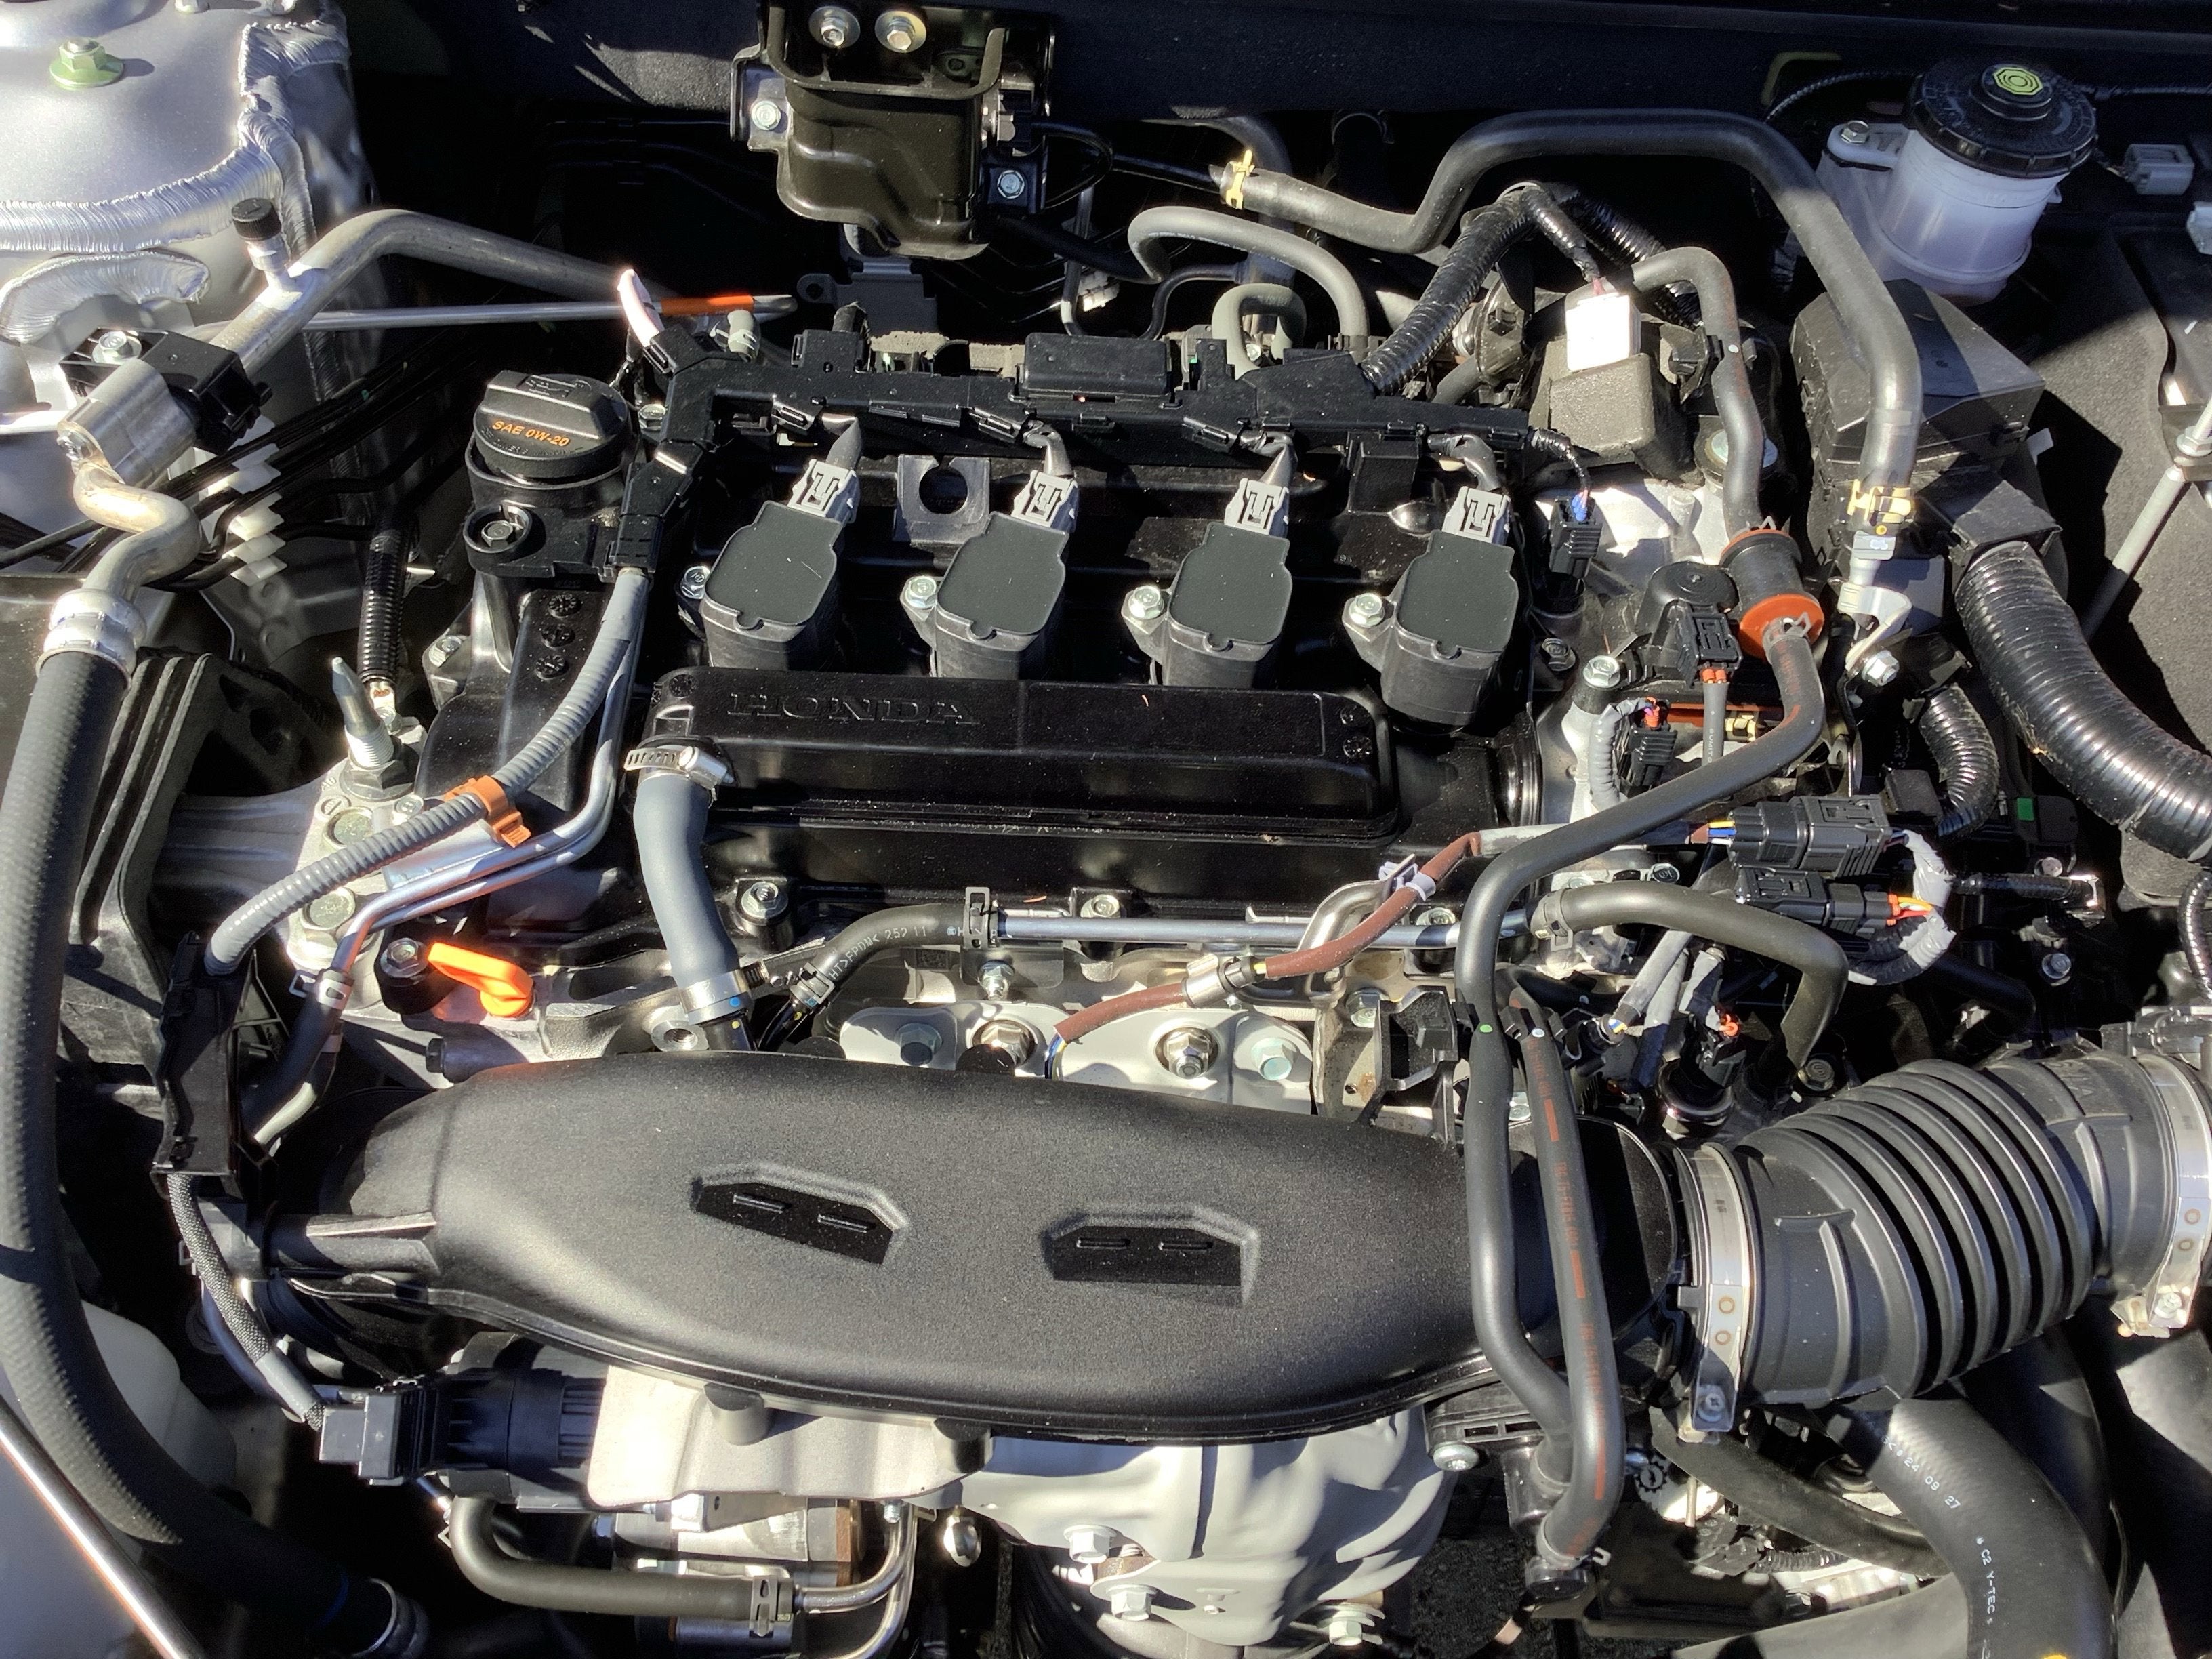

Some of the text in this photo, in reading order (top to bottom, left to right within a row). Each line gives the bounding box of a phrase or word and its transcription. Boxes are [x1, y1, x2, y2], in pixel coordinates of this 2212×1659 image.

[491, 420, 525, 435] SAE
[525, 428, 570, 447] 0W-20
[727, 693, 981, 725] HONDA
[1904, 1457, 1961, 1509] 24 09 27
[1981, 1549, 1996, 1614] C2 Y-TEC
